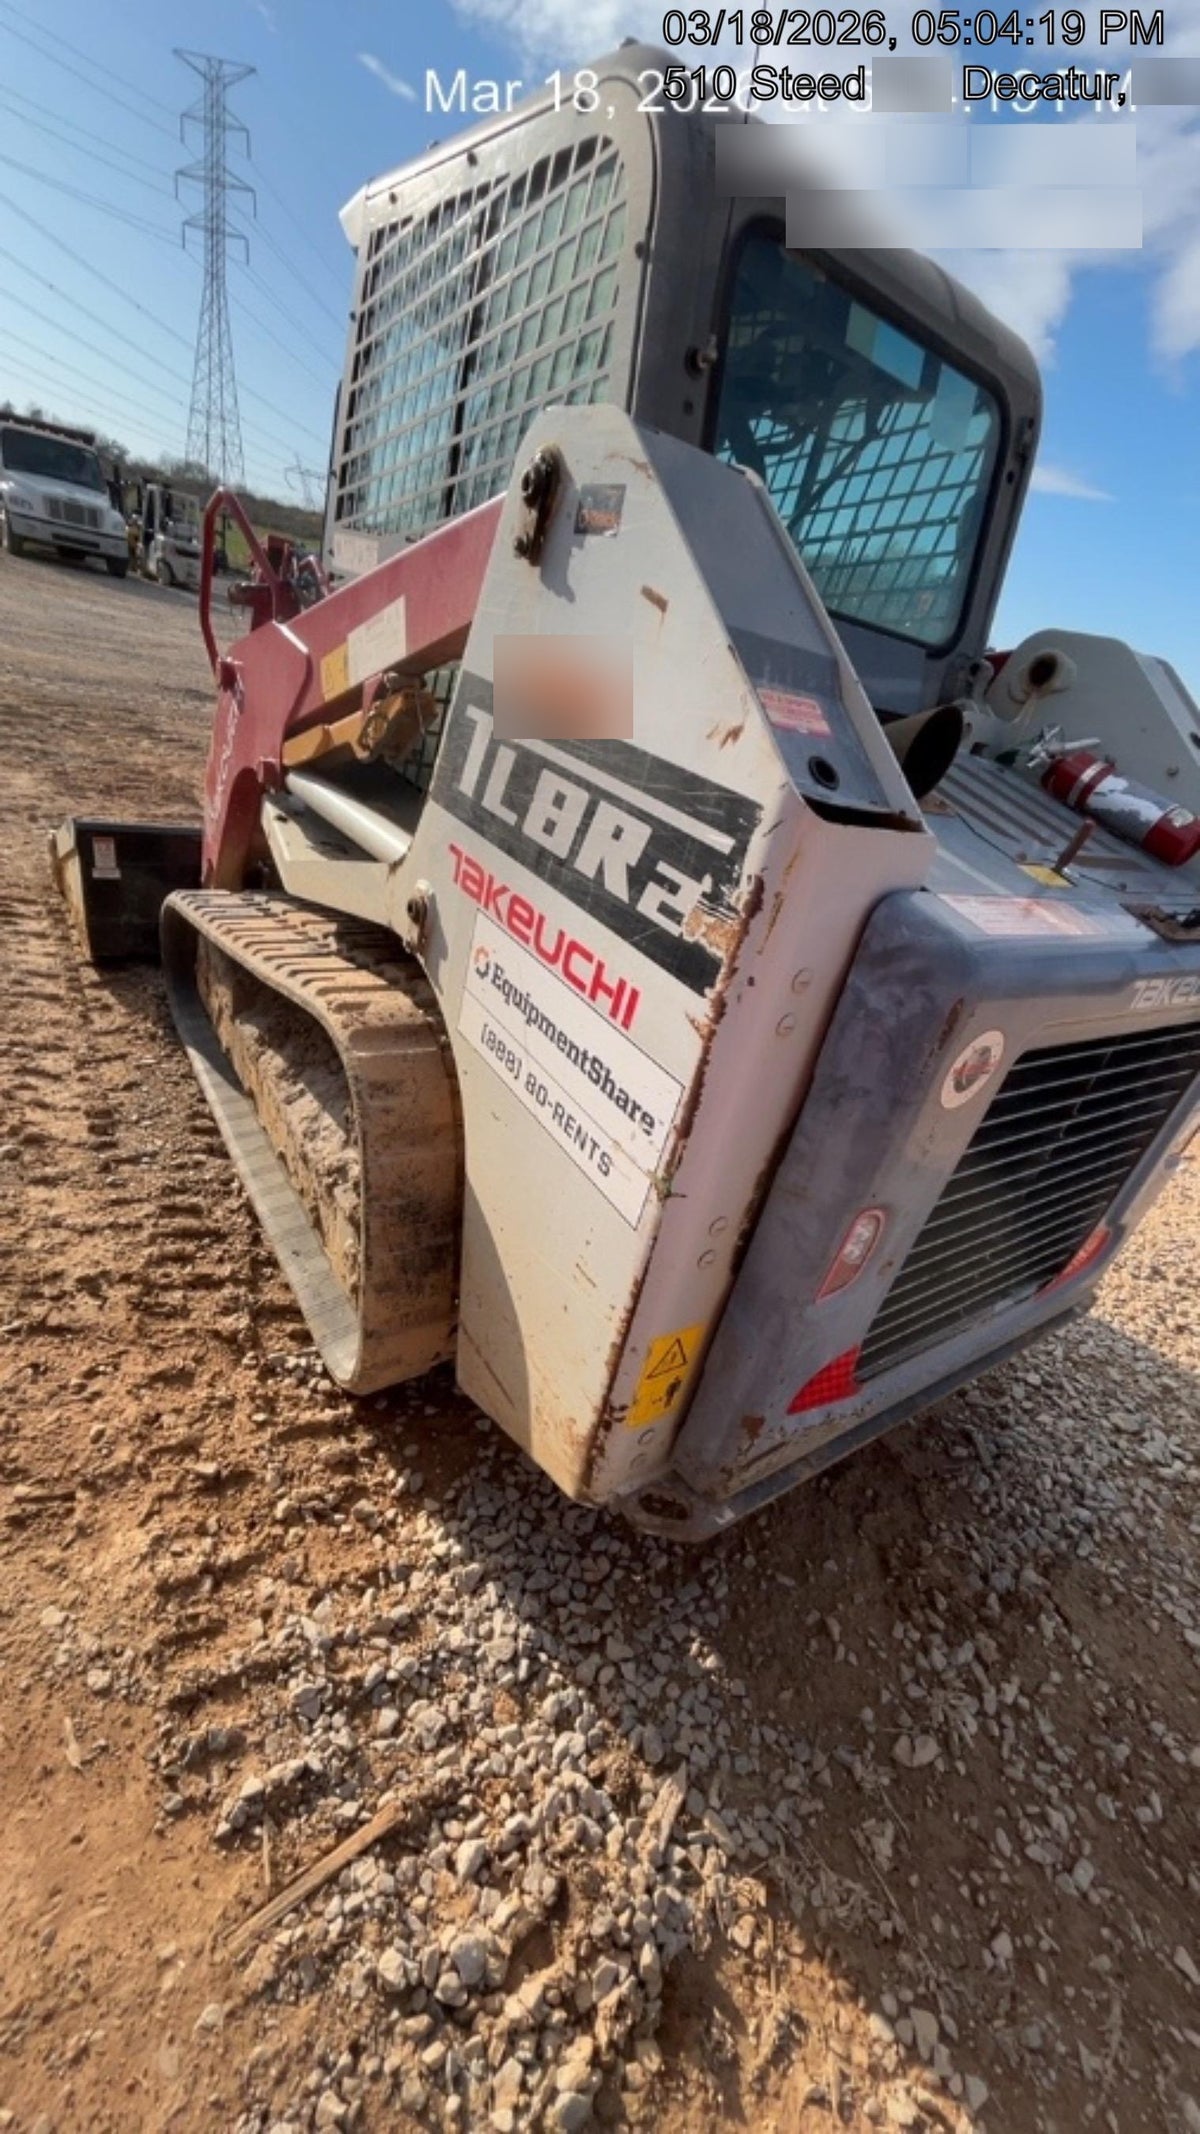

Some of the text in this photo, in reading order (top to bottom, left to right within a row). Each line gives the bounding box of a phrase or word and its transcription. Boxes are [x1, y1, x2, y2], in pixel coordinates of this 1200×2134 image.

[448, 843, 641, 1032] TAKEUCHI
[480, 1023, 614, 1177] (888) 80-RENTS
[490, 962, 656, 1137] EquipmentShare
